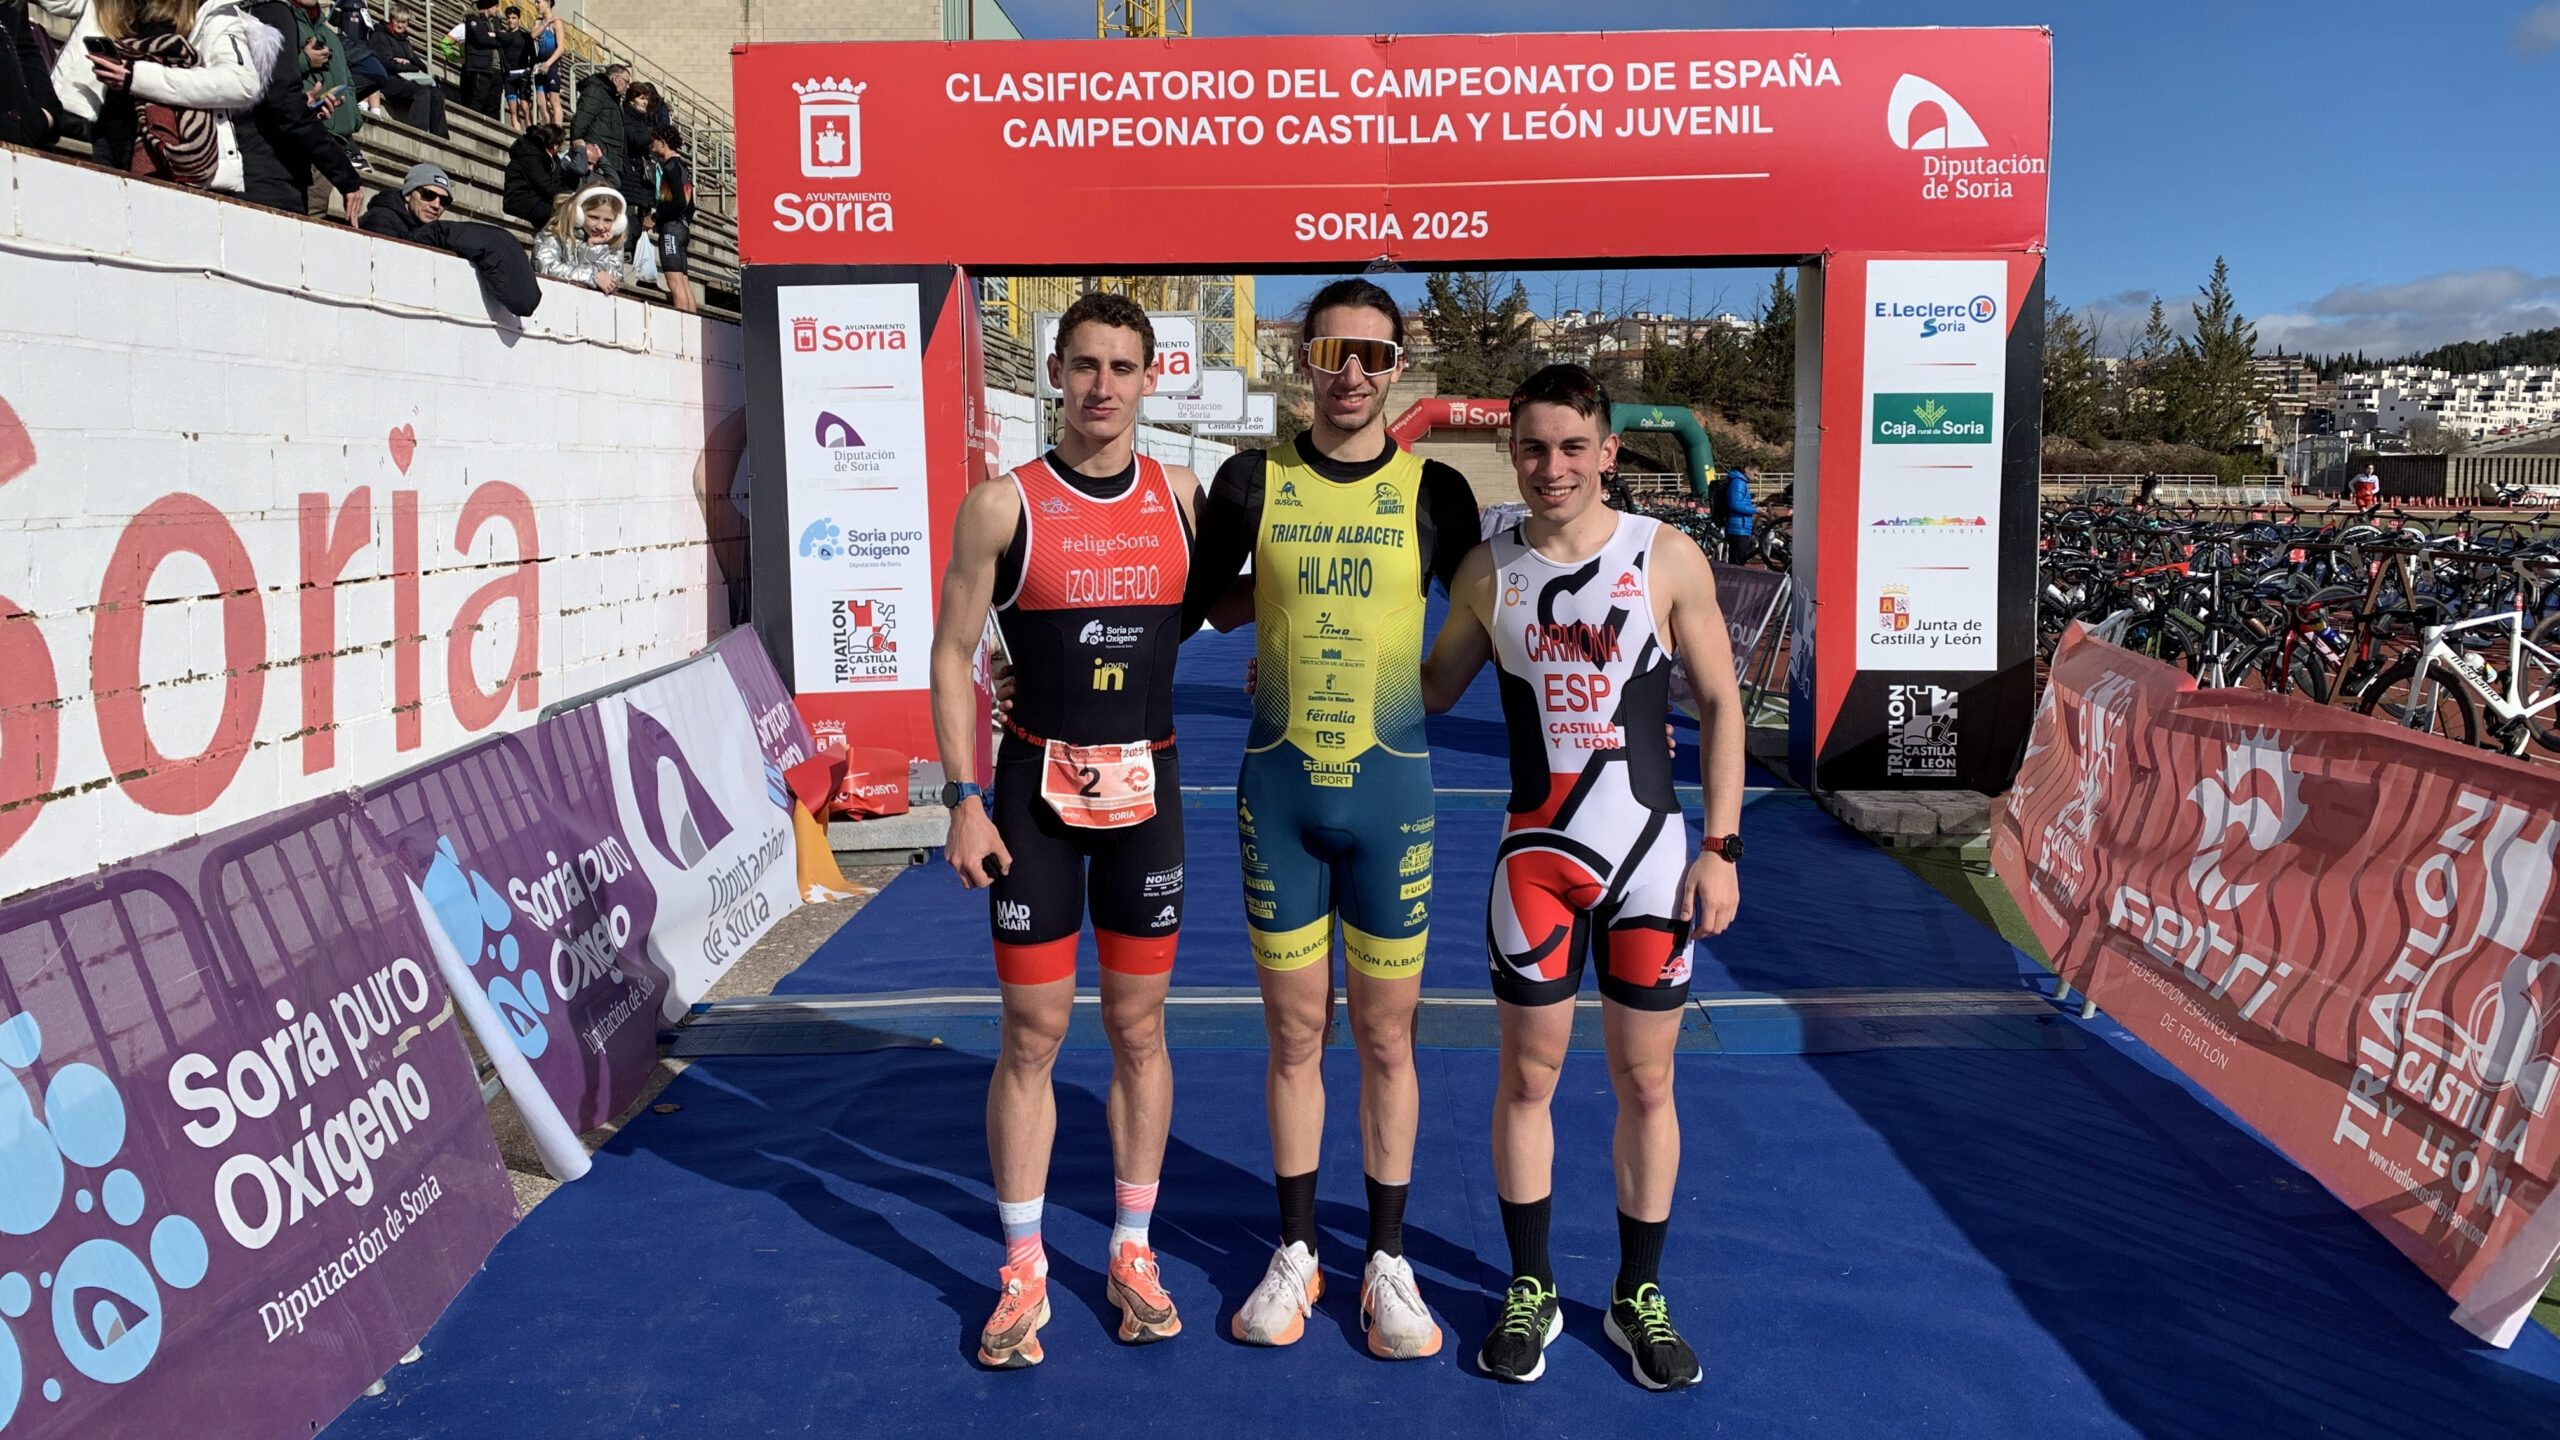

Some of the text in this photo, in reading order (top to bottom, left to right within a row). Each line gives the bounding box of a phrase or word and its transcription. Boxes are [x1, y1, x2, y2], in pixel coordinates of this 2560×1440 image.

[945, 51, 1842, 103] CLASIFICATORIO DEL CAMPEONATO DE ESPAÑA
[1002, 103, 1775, 149] CAMPEONATO CASTILLA Y LEÓN JUVENIL
[1922, 153, 2047, 181] Diputación
[805, 192, 892, 202] AYUNTAMIENTO
[1922, 176, 2014, 200] de Soria
[771, 192, 895, 234] Soria
[1294, 209, 1490, 242] SORIA 2025
[1875, 302, 1966, 318] E.Leclerc
[822, 325, 907, 352] Soria
[844, 323, 906, 331] AYUNTAMIENTO
[1920, 317, 1966, 339] Soria
[1177, 401, 1223, 414] Diputación
[1177, 410, 1211, 420] de Soria
[1880, 420, 1985, 438] Caja rural de Soria
[834, 450, 896, 463] Diputación
[834, 461, 880, 473] de Soria
[1375, 504, 1405, 516] ALBACETE
[848, 528, 923, 545] Soria puro
[1061, 530, 1161, 556] #eligeSoria
[1271, 521, 1405, 549] TRIATLÓN ALBACETE
[848, 542, 910, 560] Oxígeno
[1065, 564, 1161, 604] IZQUIERDO
[1298, 555, 1374, 599] HILARIO
[1106, 625, 1144, 636] Soria puro
[1914, 618, 1983, 632] Junta de
[832, 600, 849, 684] TRIATLON
[1105, 633, 1138, 644] Oxígeno
[1524, 623, 1623, 664] CARMONA
[1870, 632, 1982, 649] Castilla y León
[848, 655, 897, 665] CASTILLA
[849, 661, 898, 676] Y LEÓN
[1093, 657, 1125, 691] in
[2450, 655, 2502, 702] megamo
[1544, 673, 1611, 713] ESP
[1306, 708, 1356, 725] ferralia
[1549, 722, 1617, 735] CASTILLA
[1316, 730, 1346, 745] res
[1552, 734, 1621, 750] Y LEÓN
[1887, 685, 1905, 776] TRIATLON
[1903, 746, 1957, 757] CASTILLA
[1903, 755, 1957, 769] Y LEÓN
[1303, 759, 1361, 774] sanum
[1078, 766, 1102, 798] 2
[1312, 774, 1351, 785] SPORT
[1108, 809, 1136, 822] SORIA
[507, 834, 633, 932] Soria puro
[707, 826, 787, 917] Diputación
[997, 900, 1031, 921] MAD
[702, 887, 771, 967] de Soria
[550, 903, 631, 1002] Oxígeno
[2332, 791, 2496, 1152] TRIATLON
[2127, 956, 2240, 1047] FEDERACIÓN ESPAÑOLA
[168, 956, 429, 1149] Soria puro
[2159, 1012, 2231, 1071] DE TRIATLÓN
[2396, 1050, 2530, 1165] CASTILLA
[214, 1062, 431, 1250] Oxígeno
[2382, 1094, 2513, 1218] Y LEÓN
[257, 1171, 443, 1344] Diputación de Soria
